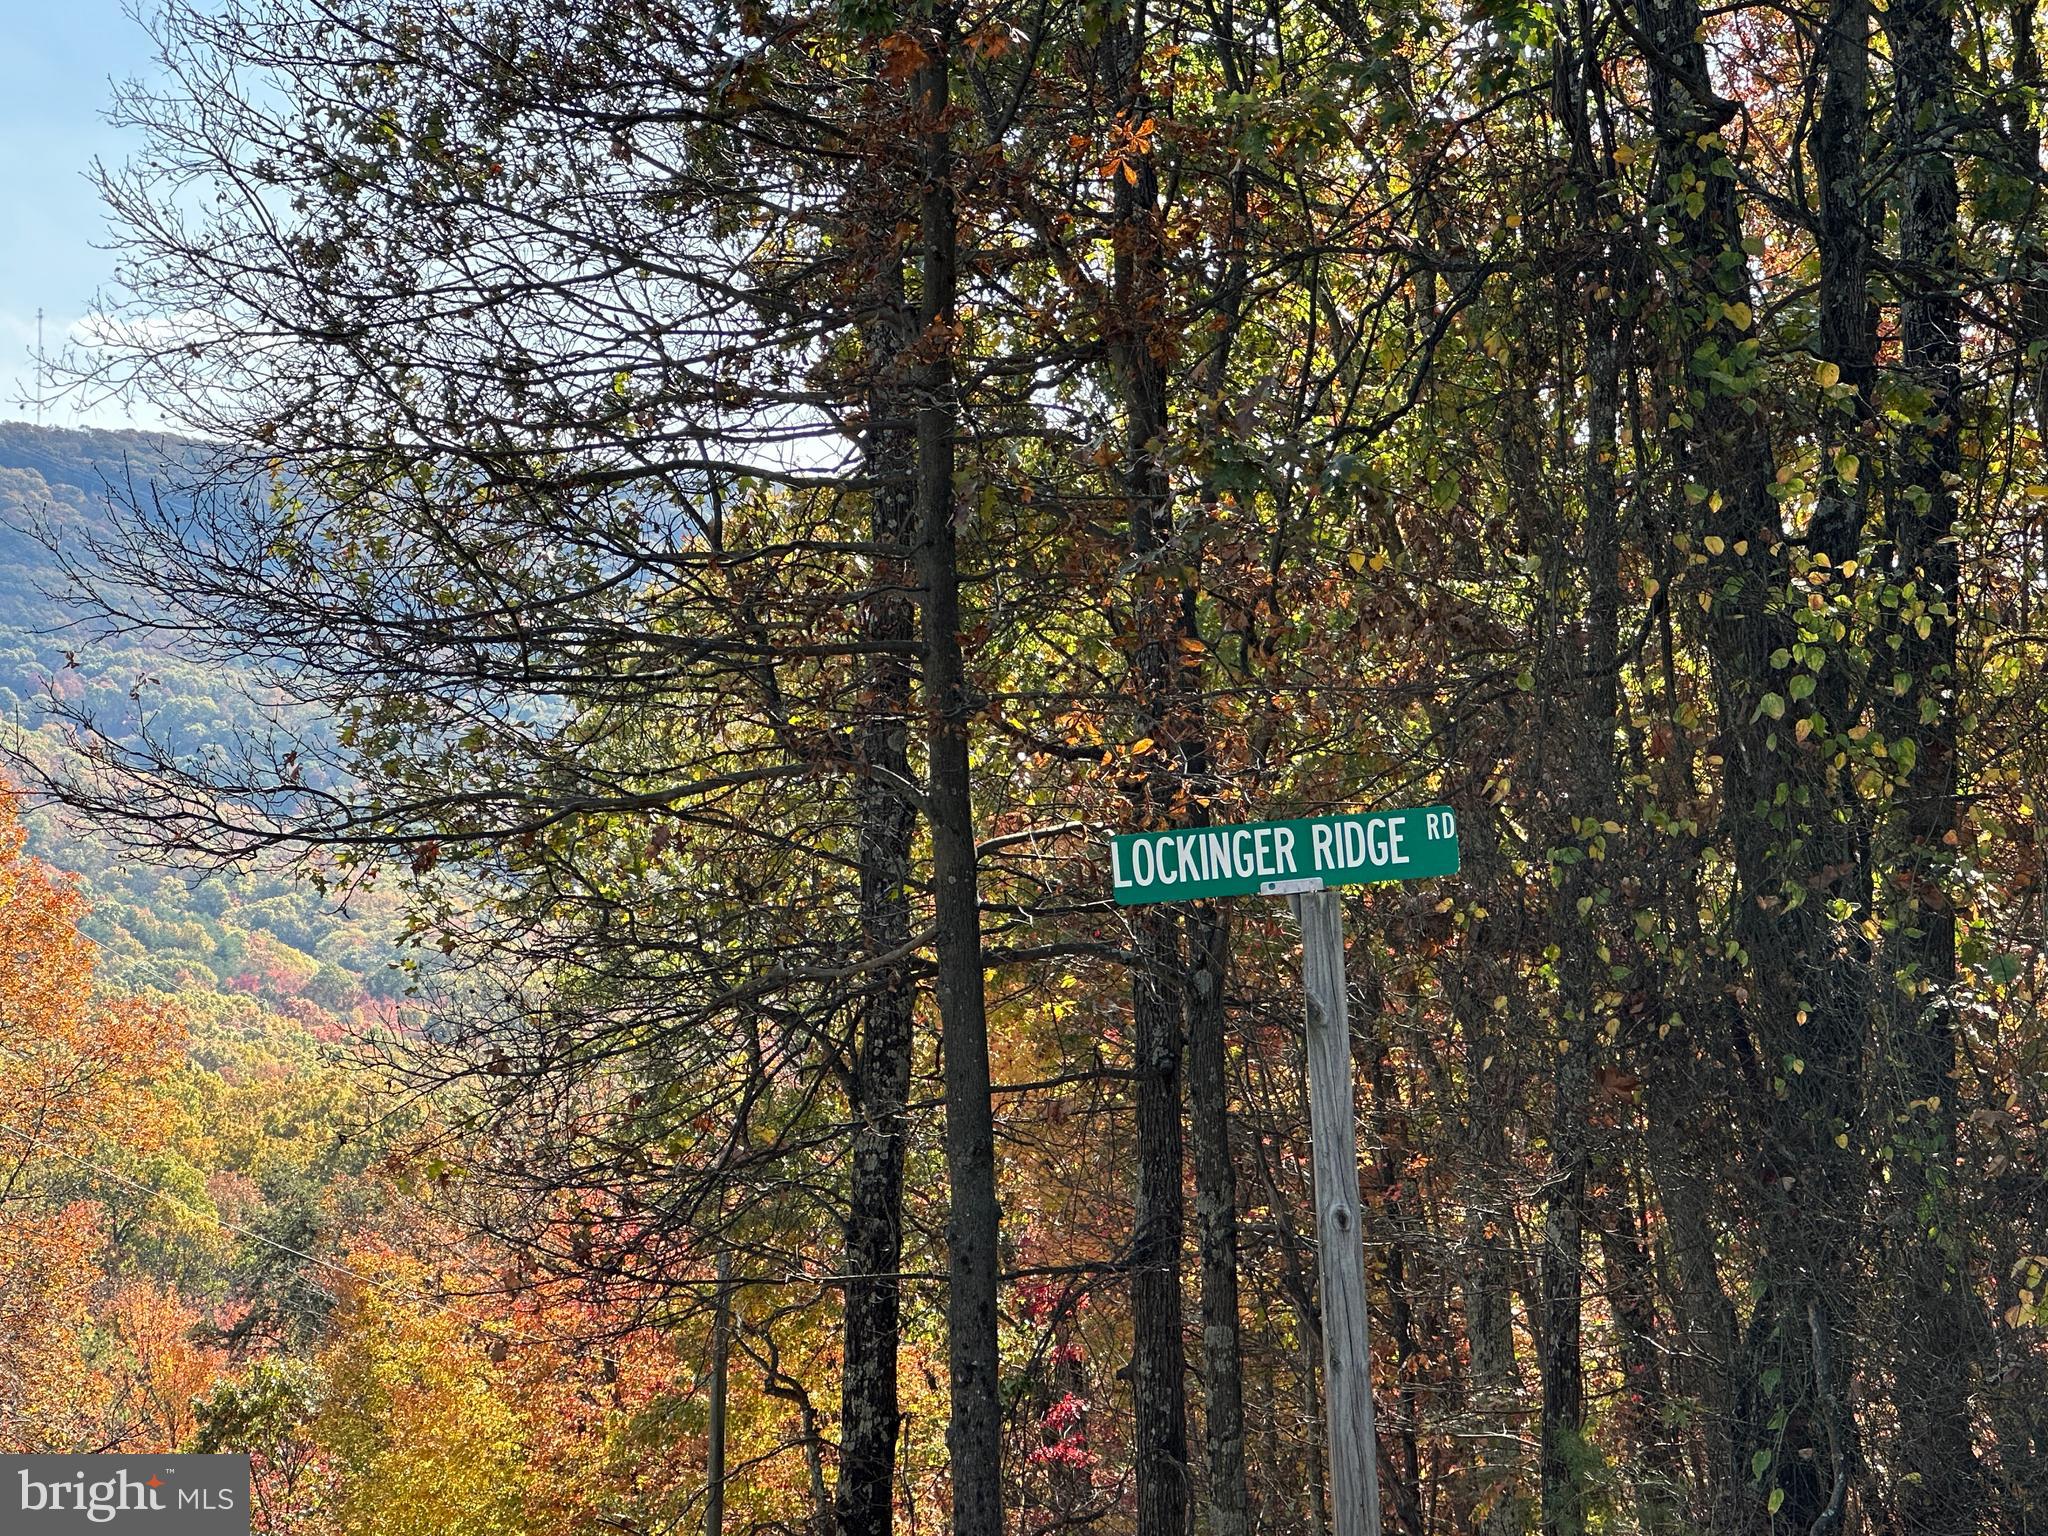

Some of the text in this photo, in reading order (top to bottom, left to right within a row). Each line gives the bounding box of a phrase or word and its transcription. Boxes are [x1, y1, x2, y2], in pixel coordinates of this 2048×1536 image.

[1110, 812, 1456, 889] LOCKINGER RIDGE RD
